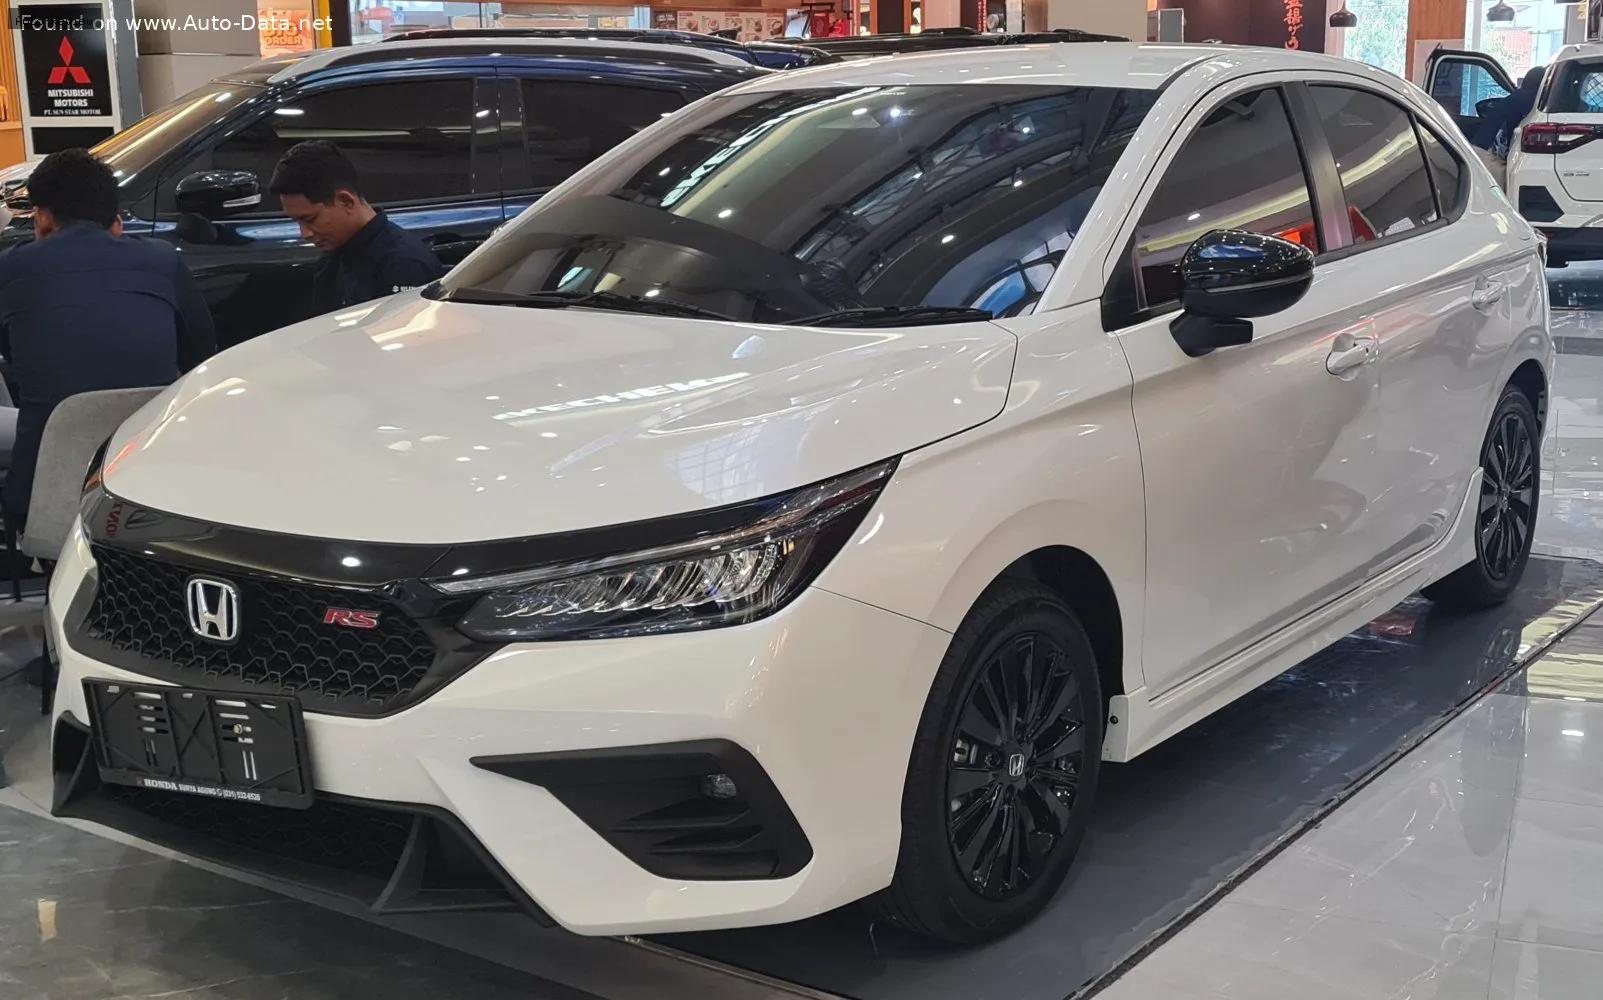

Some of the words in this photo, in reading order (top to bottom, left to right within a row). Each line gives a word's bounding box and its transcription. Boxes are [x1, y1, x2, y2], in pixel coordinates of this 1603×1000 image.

[48, 89, 94, 97] MITSUBISHI
[54, 99, 88, 107] MOTORS
[323, 608, 379, 629] RS
[144, 779, 178, 791] HONDA
